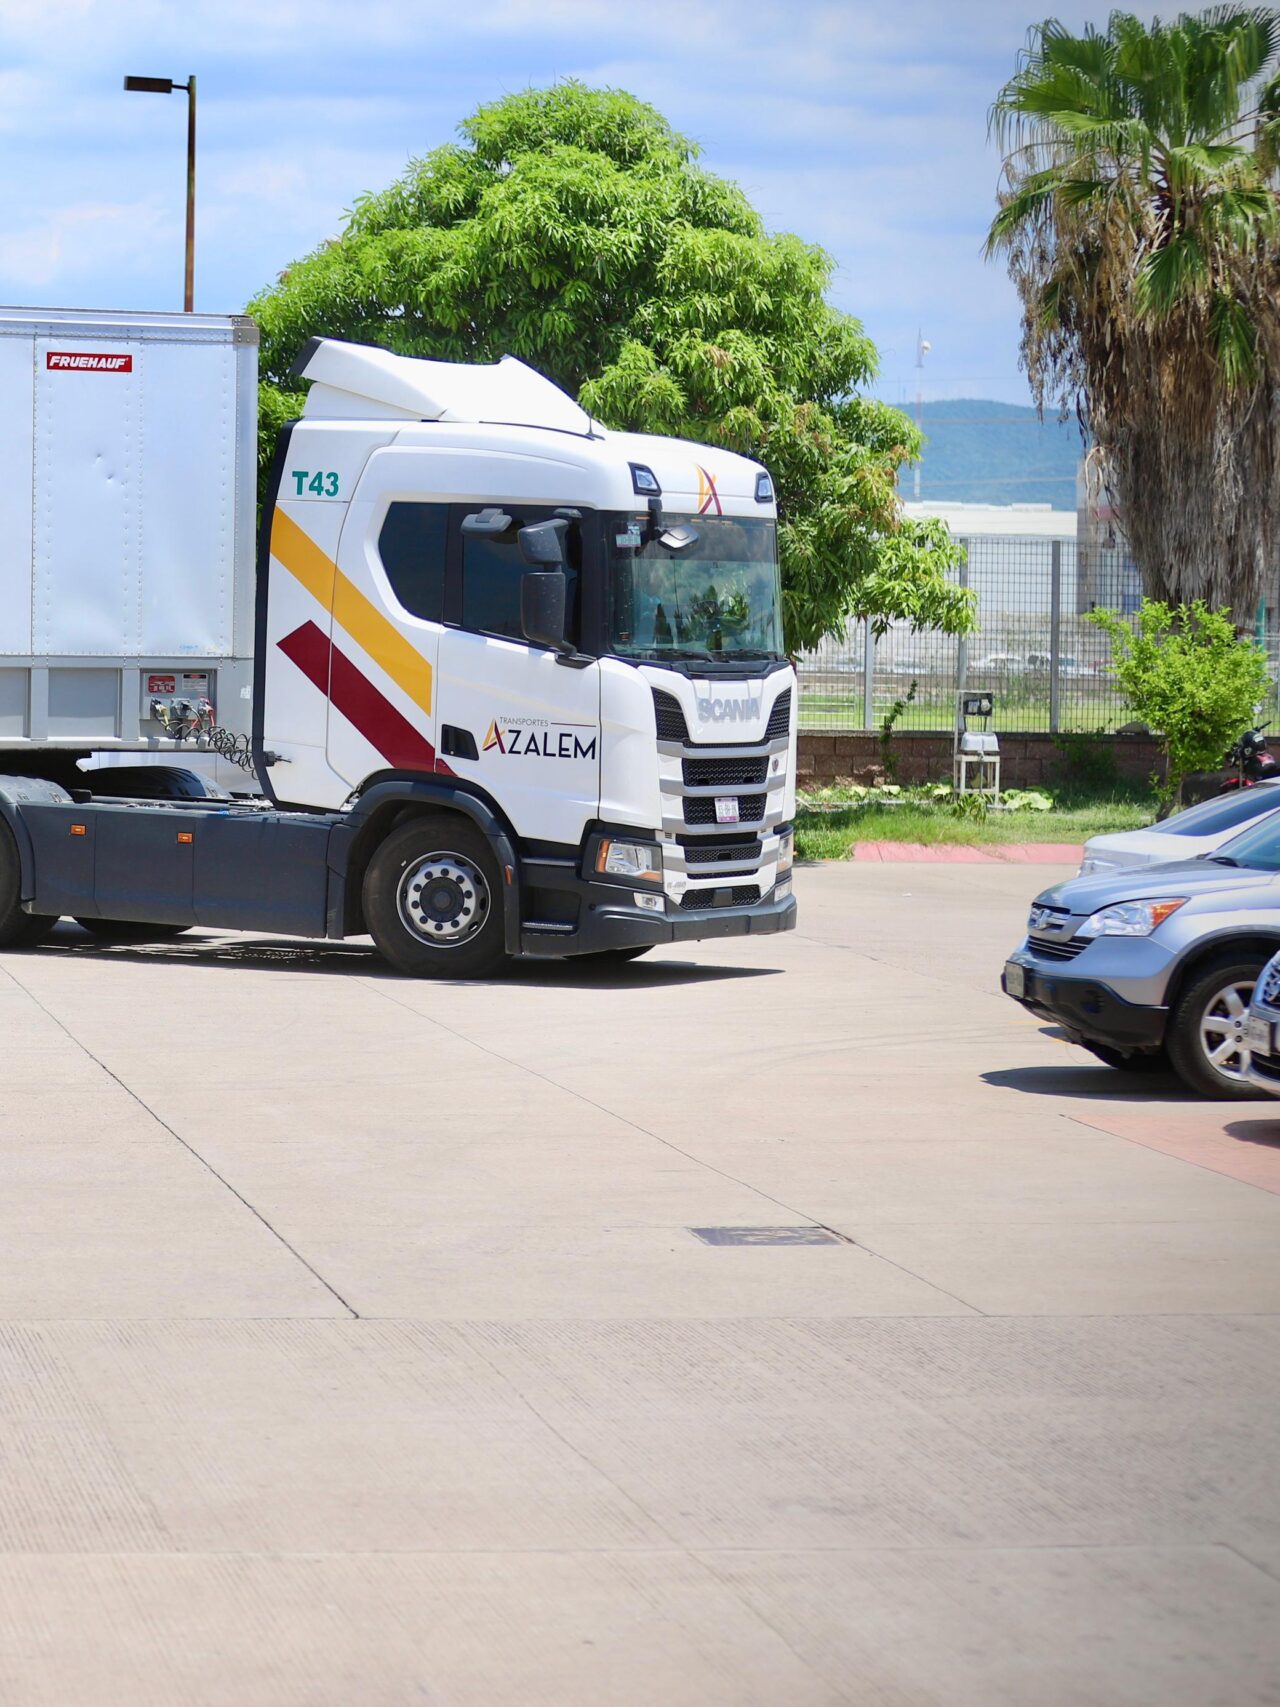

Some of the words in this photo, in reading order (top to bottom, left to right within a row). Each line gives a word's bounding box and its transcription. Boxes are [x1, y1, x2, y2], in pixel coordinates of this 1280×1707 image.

[49, 355, 127, 369] FRUEHAUF
[292, 470, 339, 497] T43
[499, 716, 549, 728] TRANSPORTES
[698, 698, 761, 723] SCANIA
[481, 719, 597, 760] AZALEM
